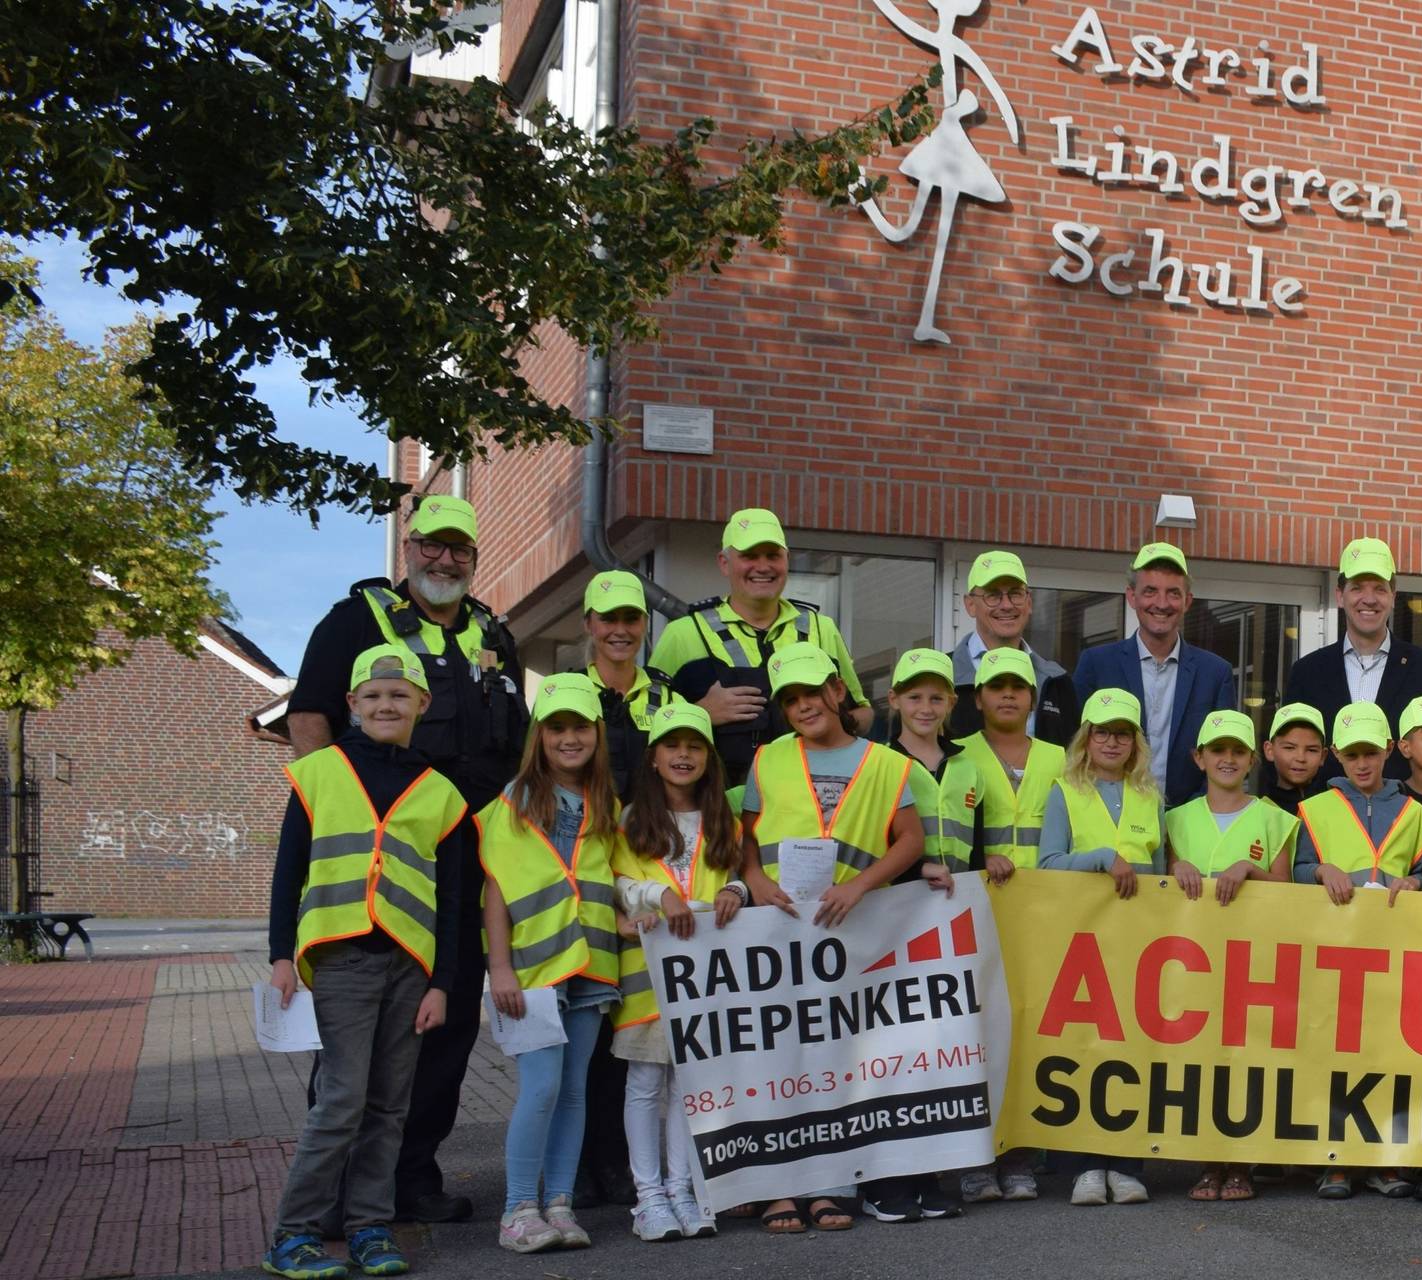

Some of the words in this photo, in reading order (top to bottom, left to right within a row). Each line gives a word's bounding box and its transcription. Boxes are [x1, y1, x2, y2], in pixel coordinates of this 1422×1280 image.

[1051, 7, 1325, 105] Astrid
[1049, 116, 1407, 228] Lindgren
[1049, 220, 1304, 311] Schule
[662, 937, 847, 1004] RADIO
[766, 1071, 836, 1100] 106.3
[859, 1052, 929, 1081] 107.4
[703, 1135, 759, 1165] 100%
[764, 1122, 845, 1152] SICHER
[847, 1109, 891, 1137] ZUR
[896, 1097, 988, 1126] SCHULE.
